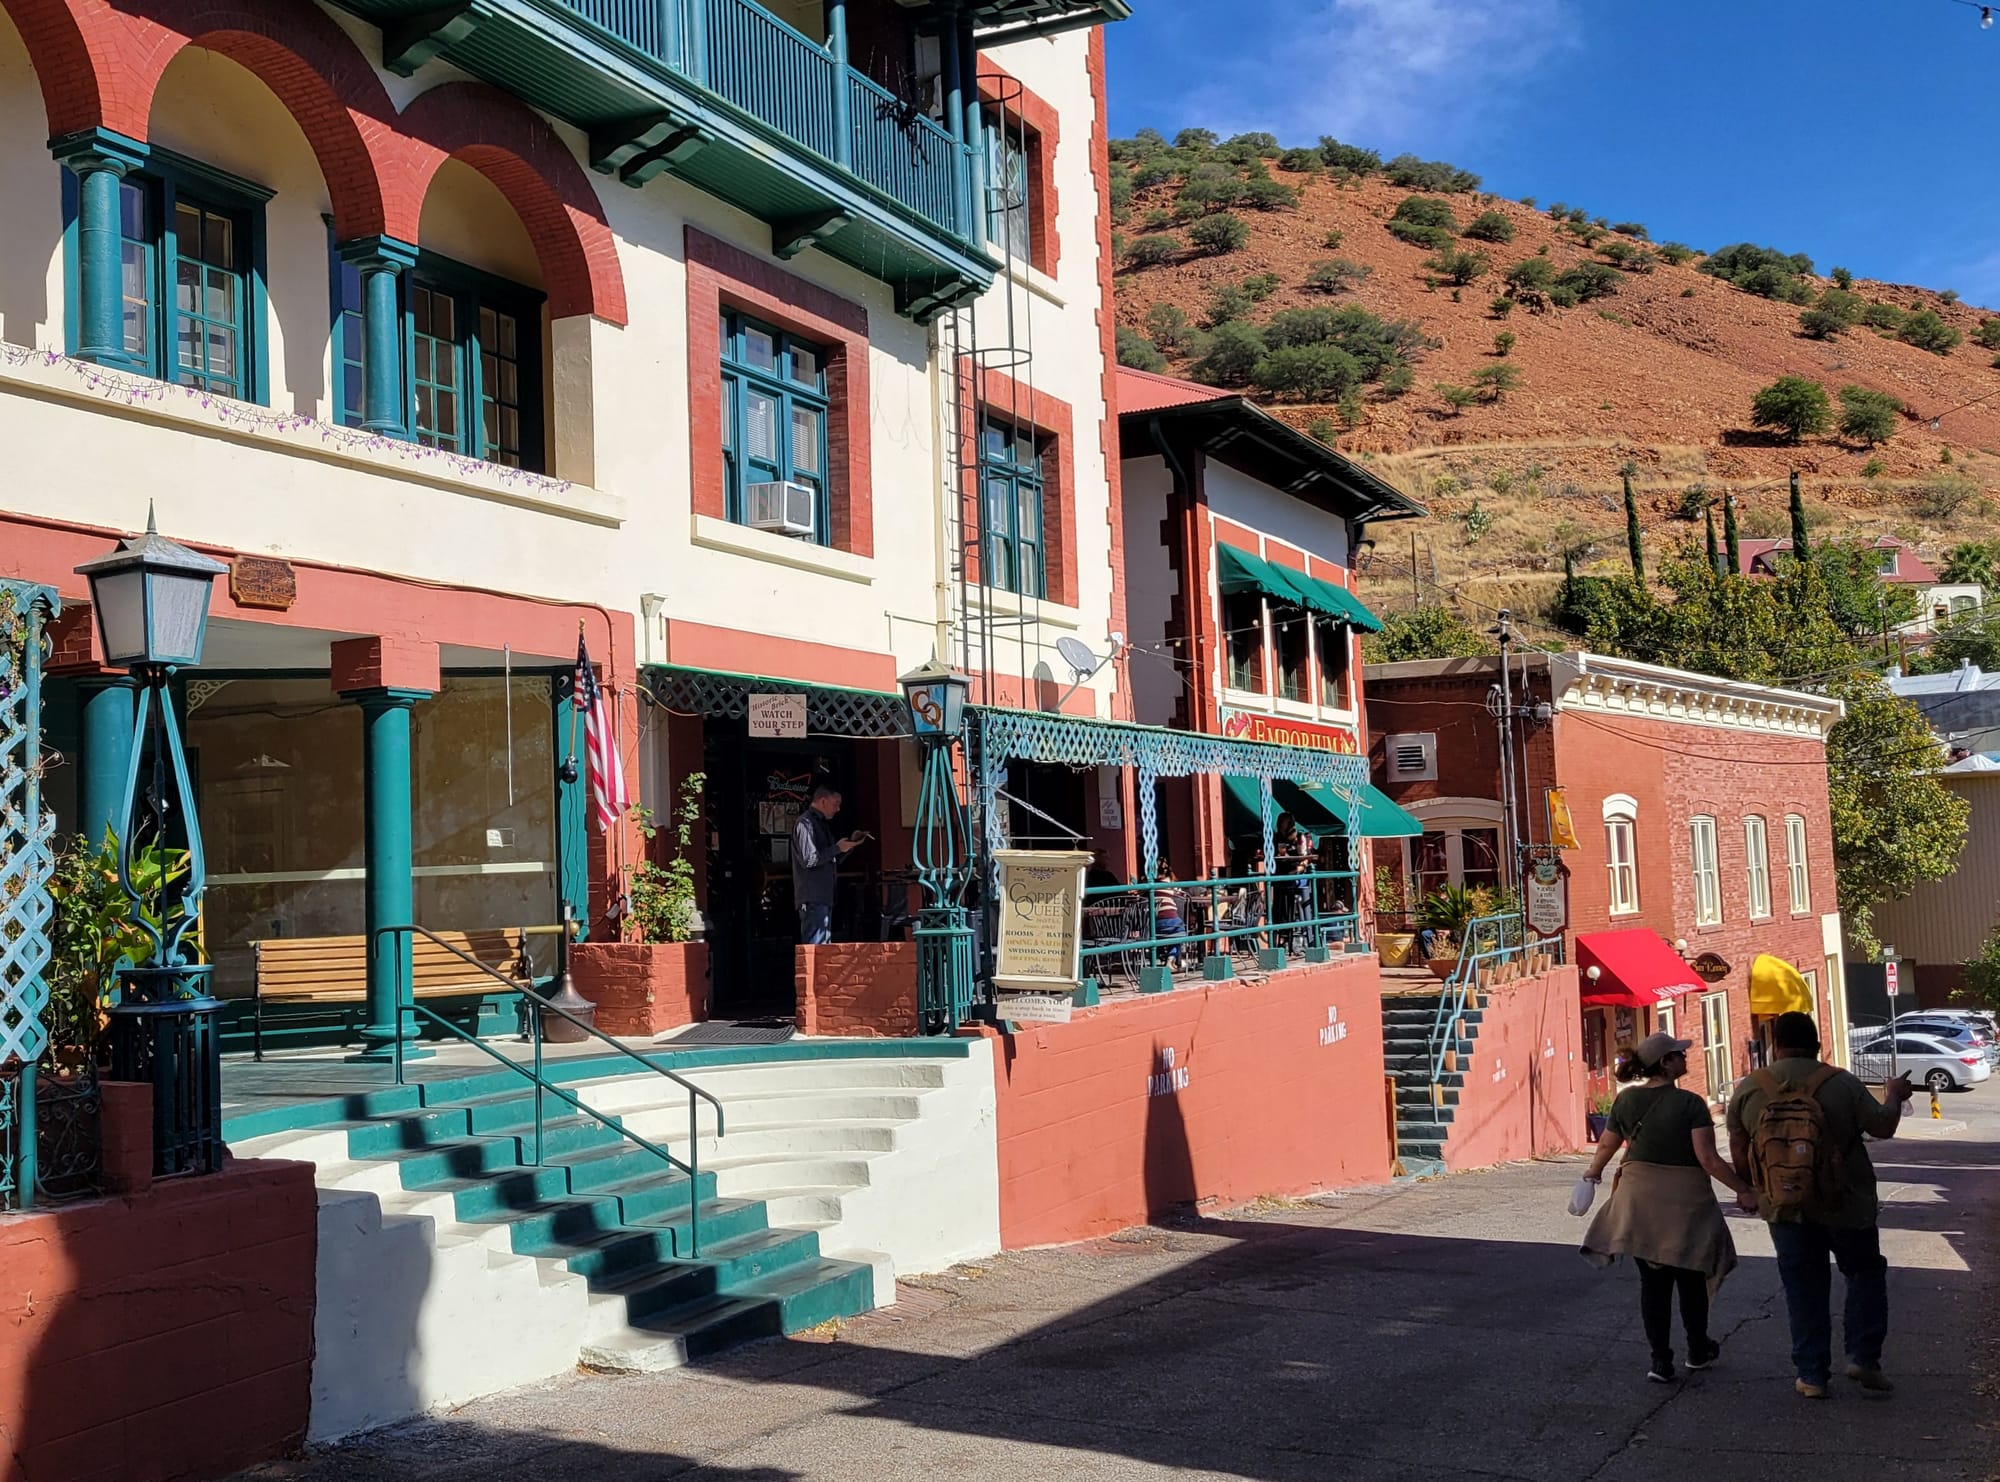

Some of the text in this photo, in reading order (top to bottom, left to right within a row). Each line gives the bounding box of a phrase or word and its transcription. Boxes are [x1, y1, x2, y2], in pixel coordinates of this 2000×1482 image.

[752, 721, 804, 729] YOUR STEP
[761, 711, 793, 719] WATCH
[1254, 719, 1338, 752] EMPORIUM
[1009, 882, 1071, 905] COPPER
[1015, 895, 1071, 921] QUEEN
[1008, 947, 1046, 955] SWIMMING
[1005, 997, 1047, 1005] WELCOMES
[1328, 1005, 1337, 1024] NO
[1319, 1021, 1347, 1047] PARKING
[1162, 1047, 1175, 1070] NO
[1148, 1066, 1189, 1097] PARKING
